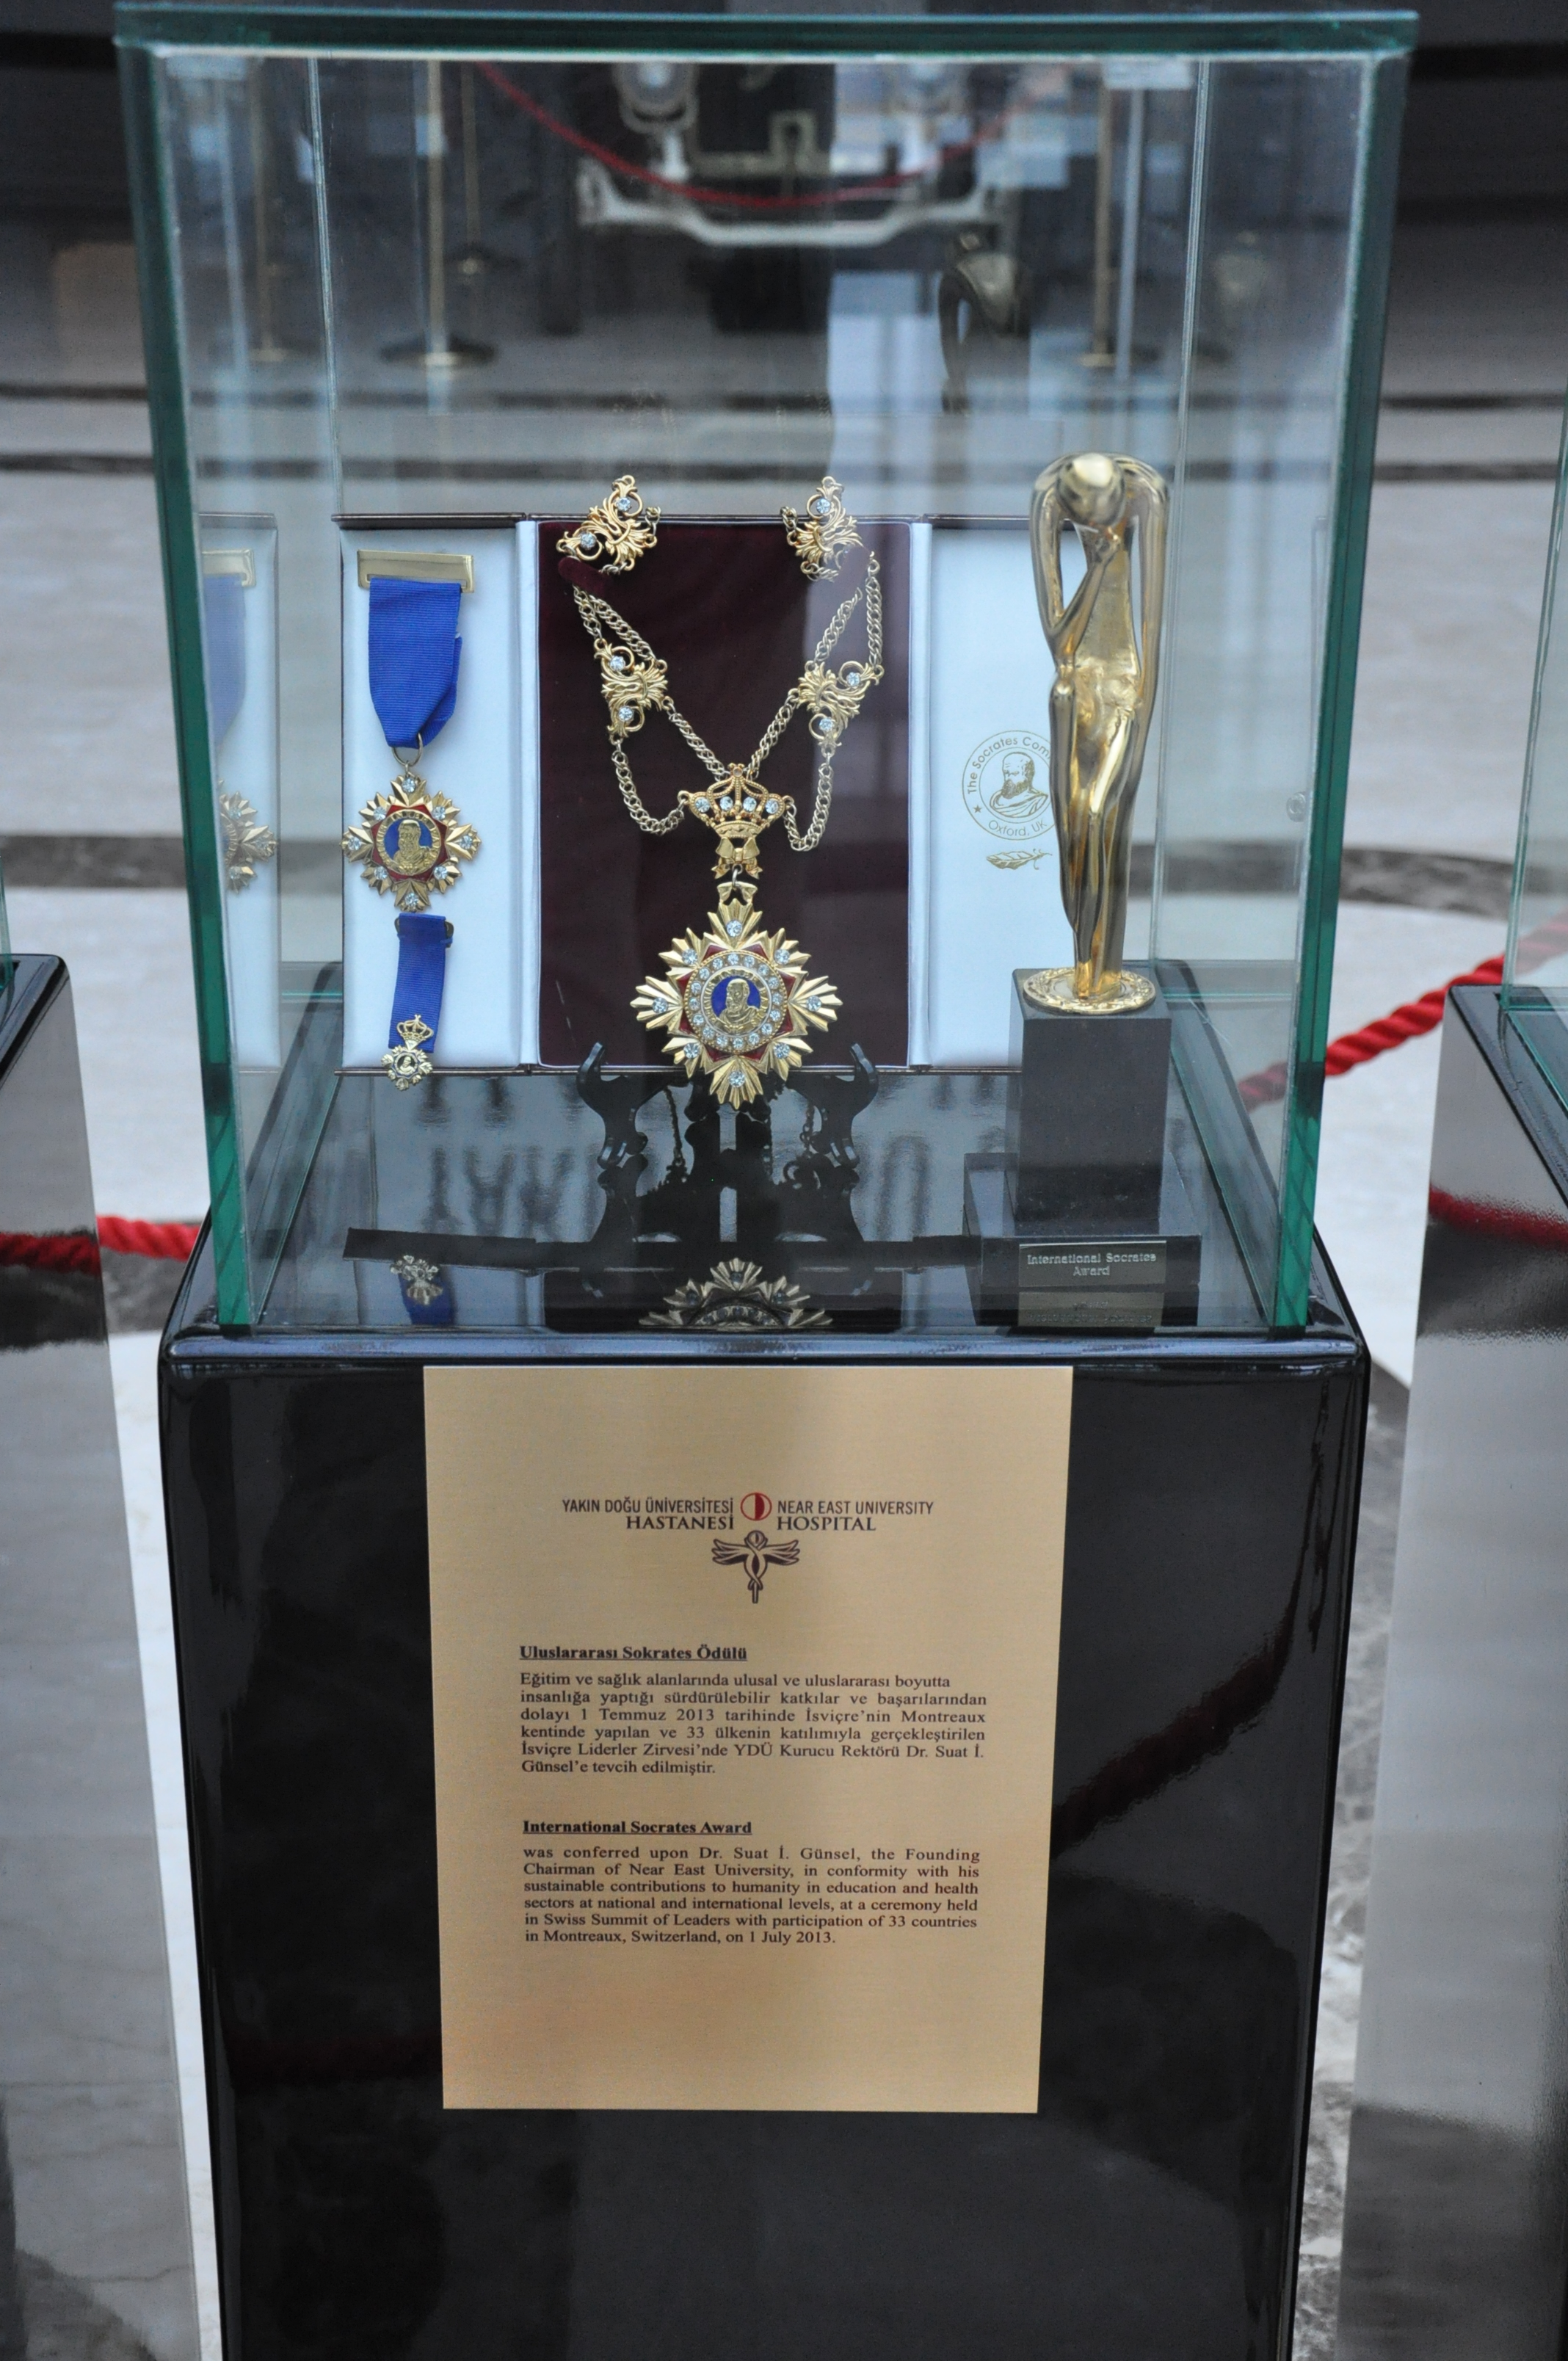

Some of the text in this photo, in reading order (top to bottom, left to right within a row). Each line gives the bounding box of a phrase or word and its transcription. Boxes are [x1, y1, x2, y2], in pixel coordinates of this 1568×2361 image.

[967, 736, 1050, 794] The Socrates Com
[1031, 820, 1048, 833] UK
[1026, 1252, 1157, 1265] International Socrates
[1072, 1265, 1110, 1276] Award
[562, 1496, 733, 1515] YAKIN DOĞU ÜNİVERSİTESİ
[778, 1501, 933, 1515] NEAR EAST UNIVERSITY
[626, 1513, 733, 1530] HASTANESİ
[777, 1516, 876, 1531] HOSPITAL
[520, 1644, 747, 1661] Uluslararası Sokrates Ödülü
[520, 1672, 950, 1690] Eğitim ve sağlık alanlarında ulusal ve uluslararası boyutta
[521, 1690, 987, 1708] insanlığa yaptığı sürdürülebilir katkılar ve başarılarından
[520, 1708, 985, 1724] dolayı 1 Temmuz 2013 tarihinde İsviçre’nin Montreaux
[521, 1725, 984, 1743] kentinde yapılan ve 33 ülkenin katılımıyla gerçekleştirilen
[522, 1741, 571, 1758] İsviçre
[578, 1743, 637, 1755] Liderler
[643, 1744, 727, 1756] Zirvesi’nde
[734, 1742, 772, 1756] YDÜ
[780, 1744, 834, 1757] Kurucu
[841, 1744, 899, 1757] Rektörü
[907, 1745, 928, 1757] Dr.
[935, 1746, 967, 1758] Suat
[522, 1760, 715, 1776] Günsel’e tevcih edilmiştir.
[523, 1820, 752, 1835] International Socrates Award
[523, 1849, 553, 1859] was
[564, 1846, 639, 1858] conferred
[650, 1850, 688, 1862] upon
[700, 1847, 722, 1859] Dr.
[734, 1847, 768, 1859] Suat
[800, 1848, 860, 1861] Günsel,
[871, 1848, 895, 1860] the
[906, 1849, 980, 1864] Founding
[523, 1863, 979, 1879] Chairman of Near East University, in conformity with his
[524, 1879, 978, 1896] sustainable contributions to humanity in education and health
[524, 1897, 977, 1914] sectors at national and international levels, at a ceremony held
[526, 1913, 977, 1929] in Swiss Summit of Leaders with participation of 33 countries
[526, 1930, 835, 1945] in Montreaux, Switzerland, on 1 July 2013.
